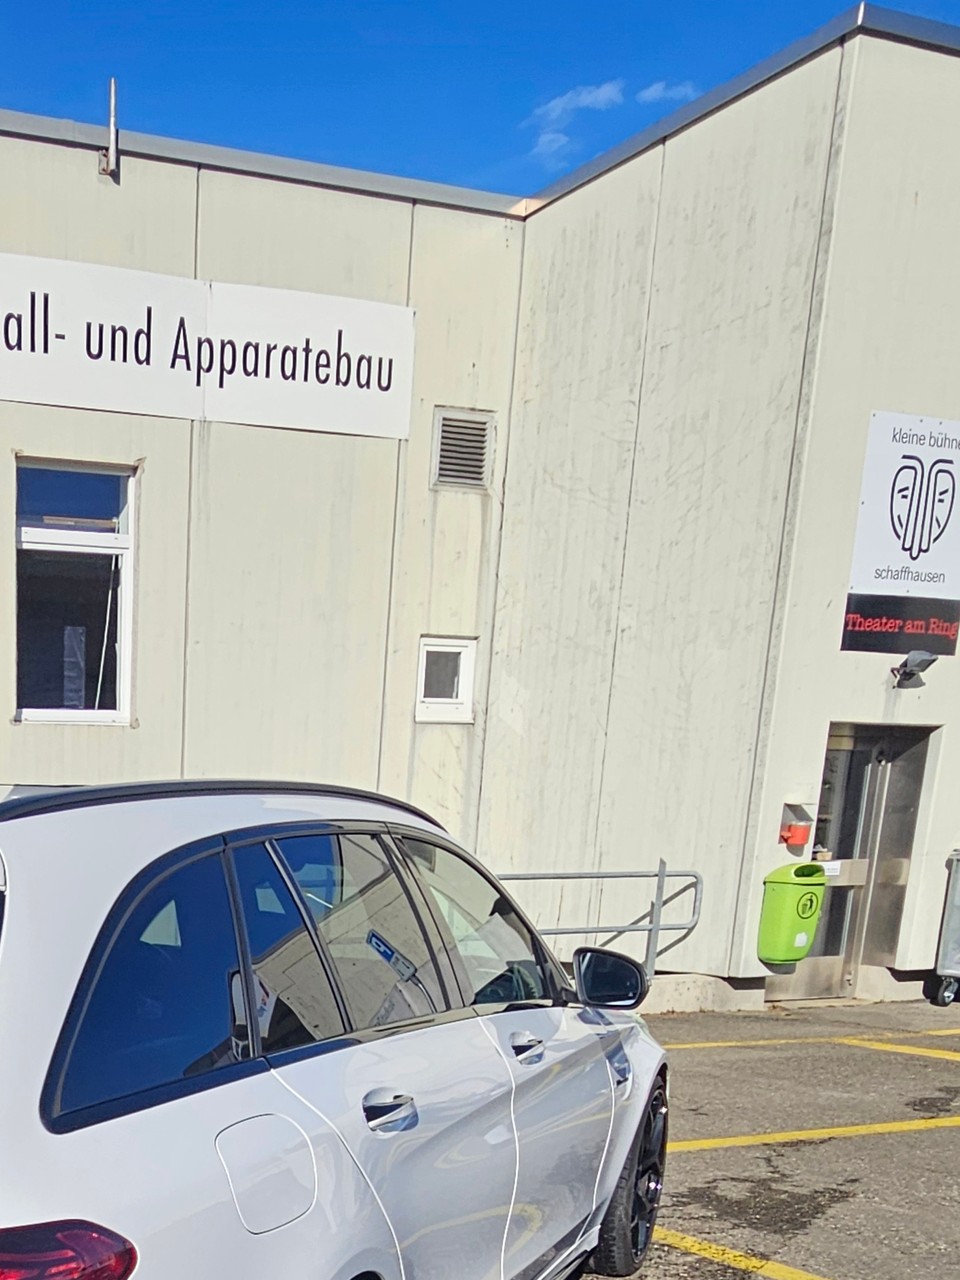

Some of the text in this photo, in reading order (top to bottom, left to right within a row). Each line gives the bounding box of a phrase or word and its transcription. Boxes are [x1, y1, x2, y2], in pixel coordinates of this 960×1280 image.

[85, 306, 153, 367] und
[170, 317, 395, 393] Apparatebau
[892, 427, 926, 446] kleine
[874, 565, 946, 583] schaffhausen
[846, 613, 959, 640] Theater am Ring
